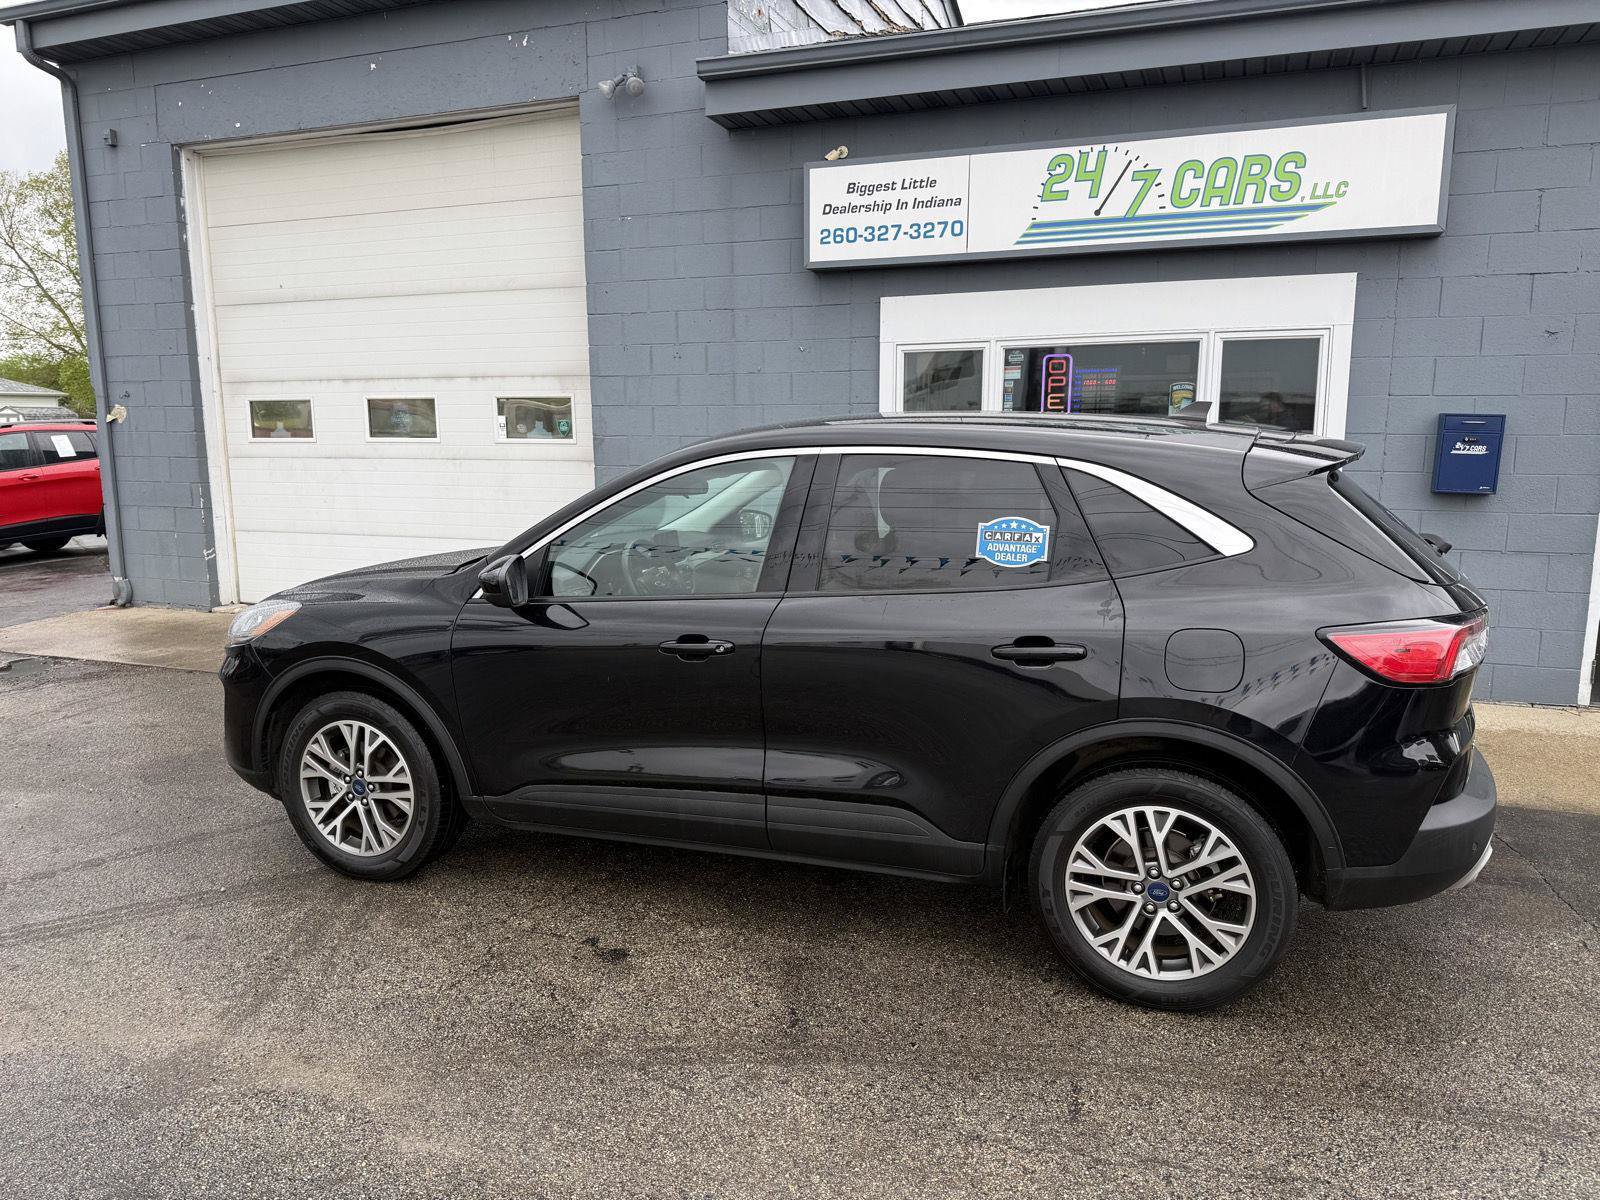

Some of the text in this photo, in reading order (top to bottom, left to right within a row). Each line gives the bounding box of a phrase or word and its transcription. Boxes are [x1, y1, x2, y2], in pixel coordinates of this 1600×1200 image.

[846, 176, 937, 196] Biggest Little
[1310, 181, 1350, 200] LLC
[822, 196, 962, 215] Dealership In Indiana
[819, 219, 964, 245] 260-327-3270
[1047, 359, 1067, 411] OPE
[984, 530, 1042, 543] CARFAX
[986, 543, 1038, 553] ADVANTAGE
[994, 552, 1028, 562] DEALER
